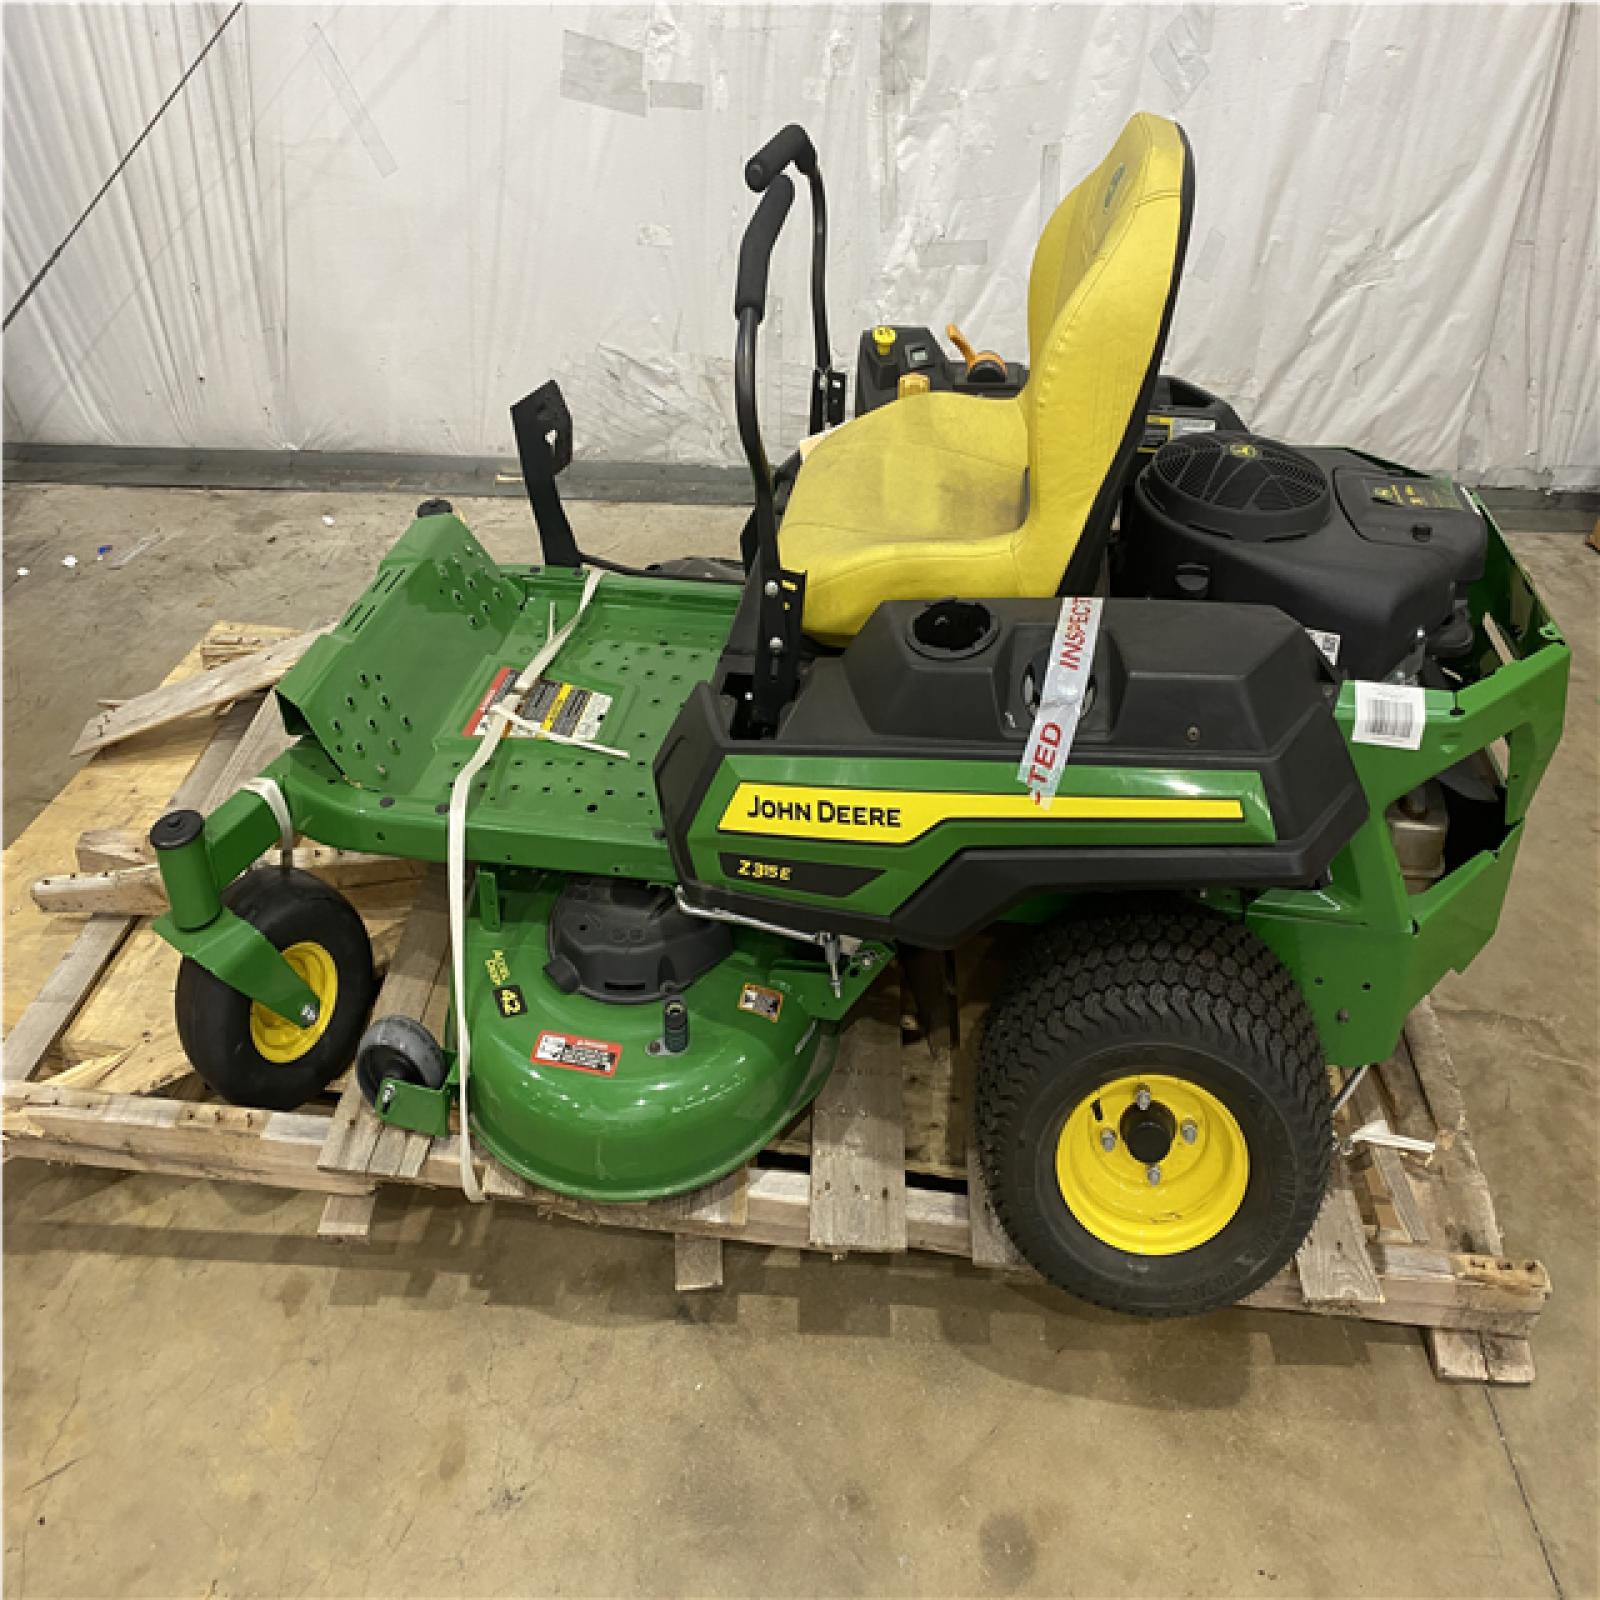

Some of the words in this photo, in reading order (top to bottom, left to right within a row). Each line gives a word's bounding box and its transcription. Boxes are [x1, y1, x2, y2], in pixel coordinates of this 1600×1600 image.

[1027, 722, 1062, 804] TED
[747, 795, 811, 822] JOHN
[817, 800, 901, 828] DEERE
